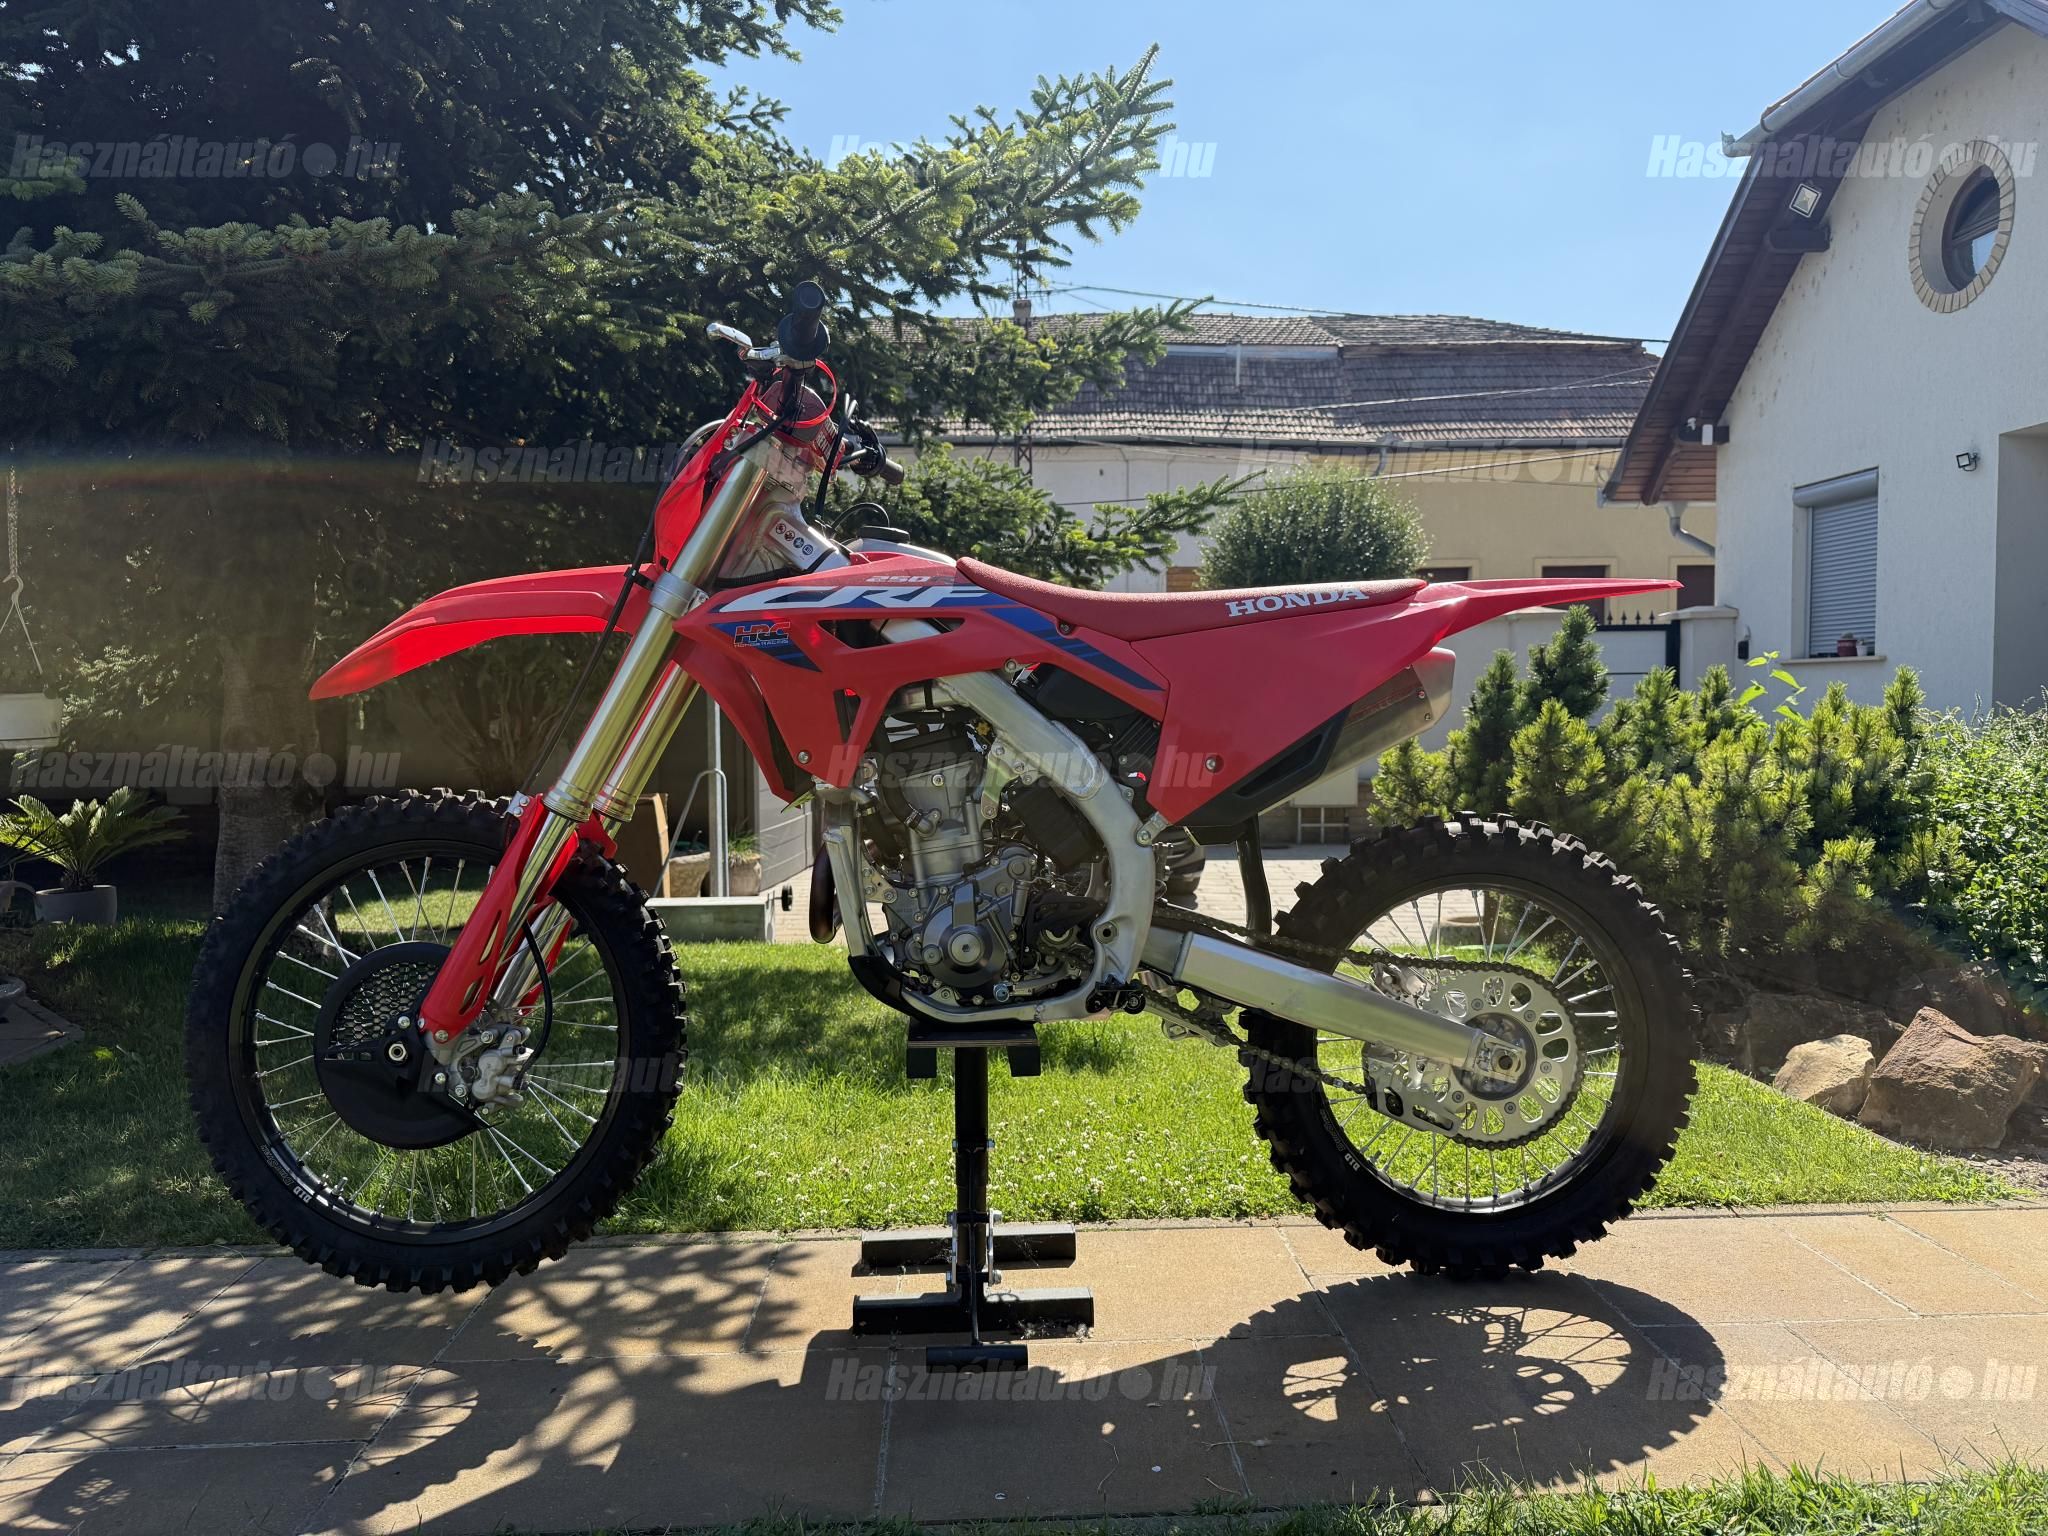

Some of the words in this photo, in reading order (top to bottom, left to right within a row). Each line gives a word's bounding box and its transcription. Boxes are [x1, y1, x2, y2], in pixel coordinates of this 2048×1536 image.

[719, 585, 989, 613] CRF
[1225, 586, 1370, 617] HONDA
[734, 621, 791, 645] HRC
